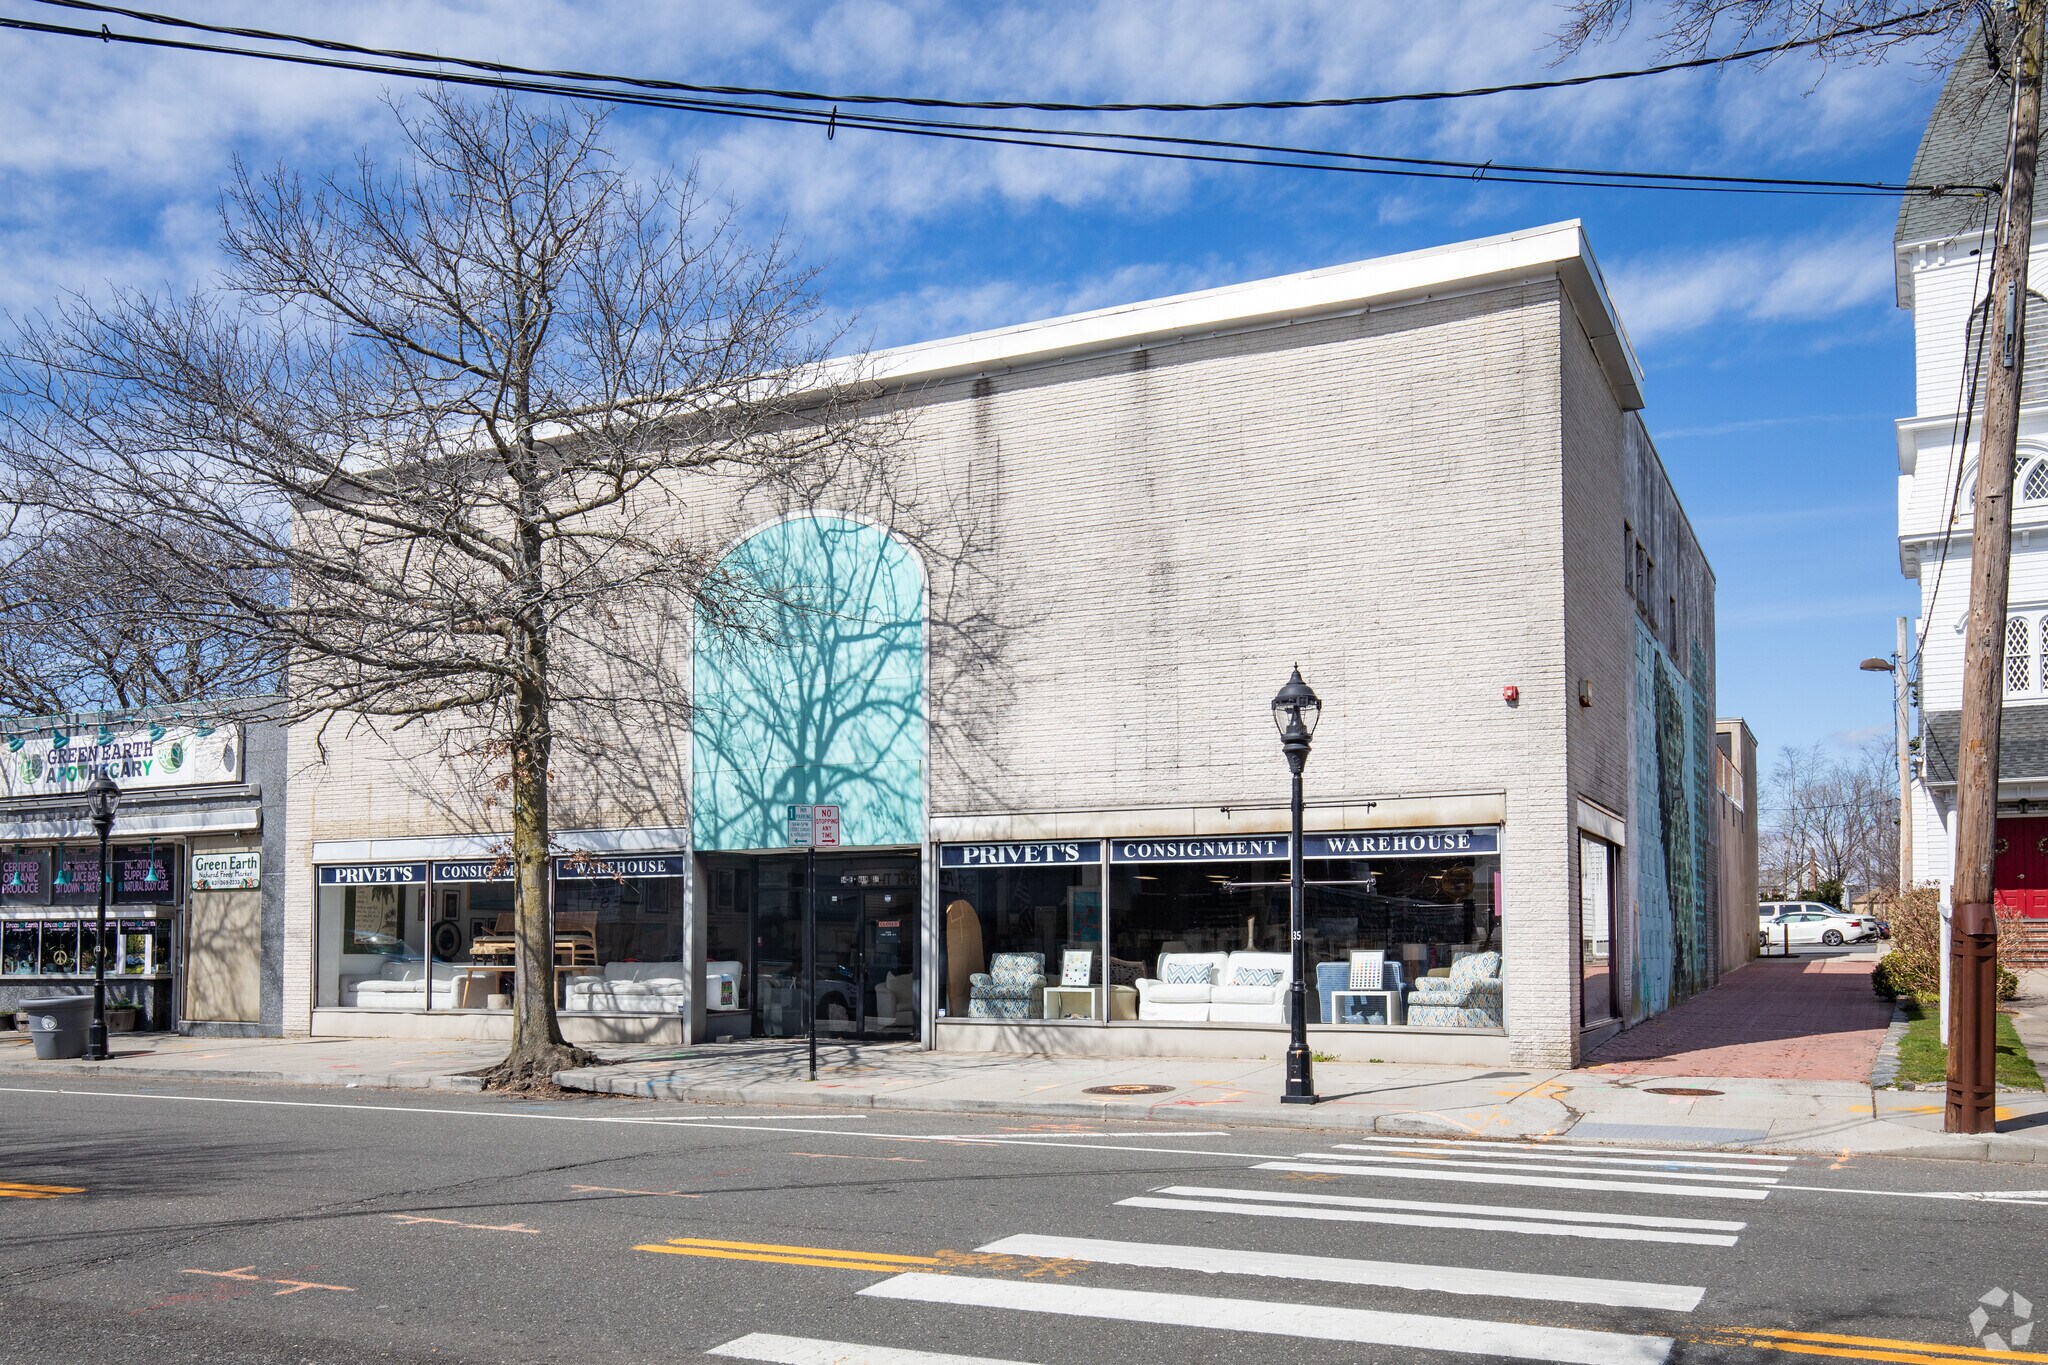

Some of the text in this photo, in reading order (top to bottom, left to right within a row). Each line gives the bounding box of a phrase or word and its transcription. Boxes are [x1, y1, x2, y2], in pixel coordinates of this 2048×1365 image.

[47, 741, 154, 765] GREEN EARTH
[821, 809, 832, 818] NO
[1123, 839, 1277, 858] CONSIGNMENT
[1327, 833, 1471, 853] WAREHOUSE
[962, 843, 1080, 864] PRIVET'S
[63, 861, 86, 871] ORANIC
[195, 856, 257, 871] Green Earth
[574, 860, 667, 875] WAREHOUSE
[3, 872, 39, 883] ORANIC
[335, 866, 413, 883] PRIVET'S
[442, 865, 514, 878] CONSIGM
[2, 883, 39, 894] PRODUCE
[123, 880, 145, 892] NATURAL
[144, 881, 158, 891] BODY
[157, 880, 169, 891] CARE
[1292, 930, 1302, 940] 35
